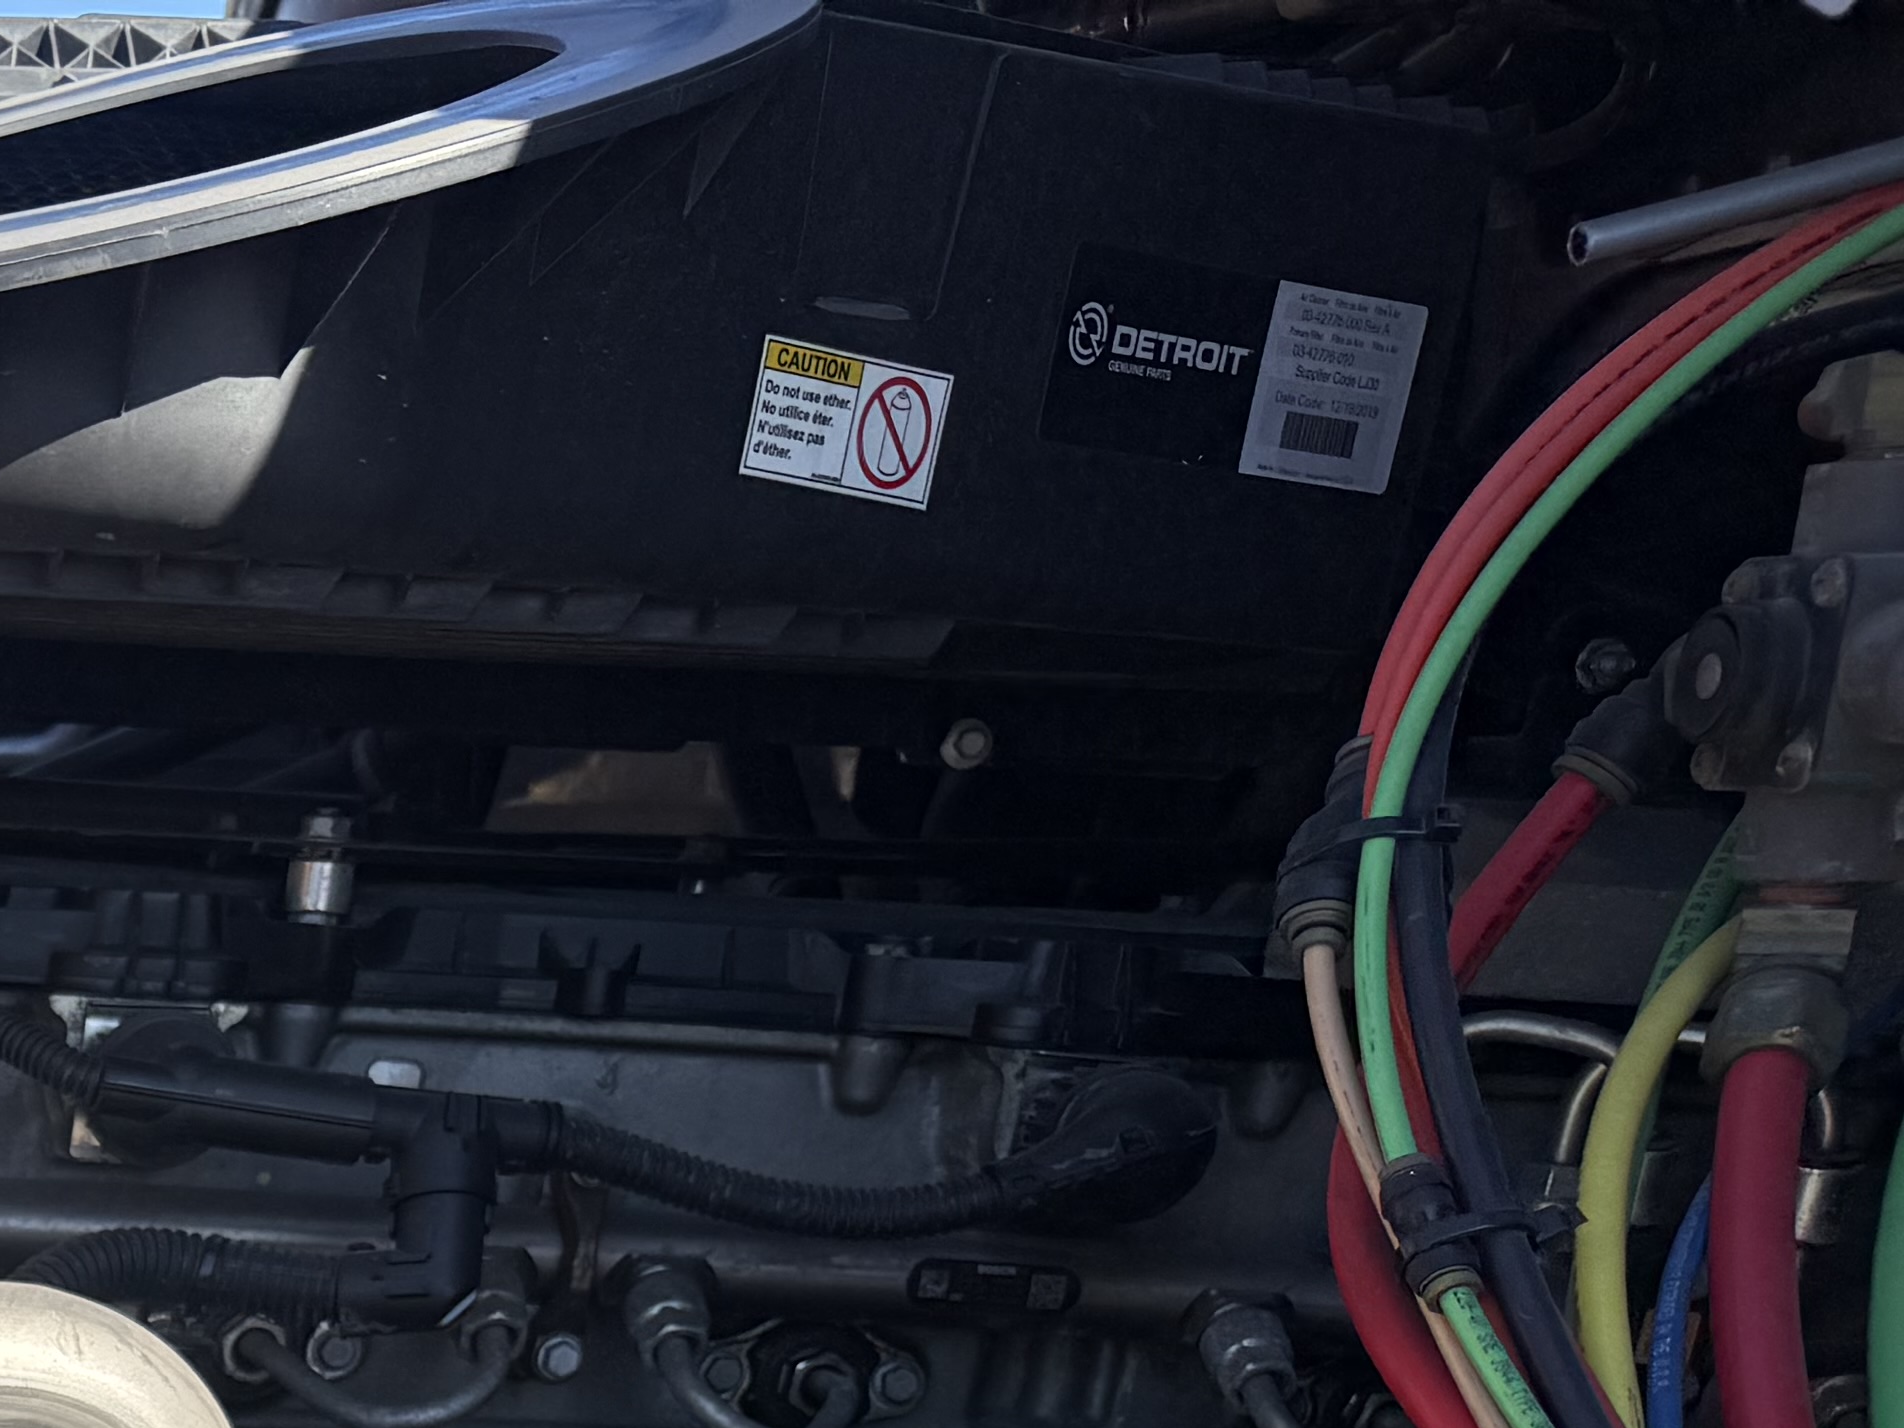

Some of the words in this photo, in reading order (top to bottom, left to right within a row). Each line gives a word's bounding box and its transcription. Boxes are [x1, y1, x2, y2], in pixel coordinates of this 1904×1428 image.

[1111, 324, 1251, 375] DETROIT
[777, 347, 852, 382] CAUTION
[1108, 360, 1143, 376] GENUINE
[1146, 367, 1172, 381] PARTS
[765, 379, 779, 395] Do
[782, 386, 800, 399] not
[802, 391, 821, 403] use
[823, 393, 852, 410] ether.
[761, 399, 776, 415] No
[778, 405, 810, 421] utilice
[806, 432, 825, 448] pas
